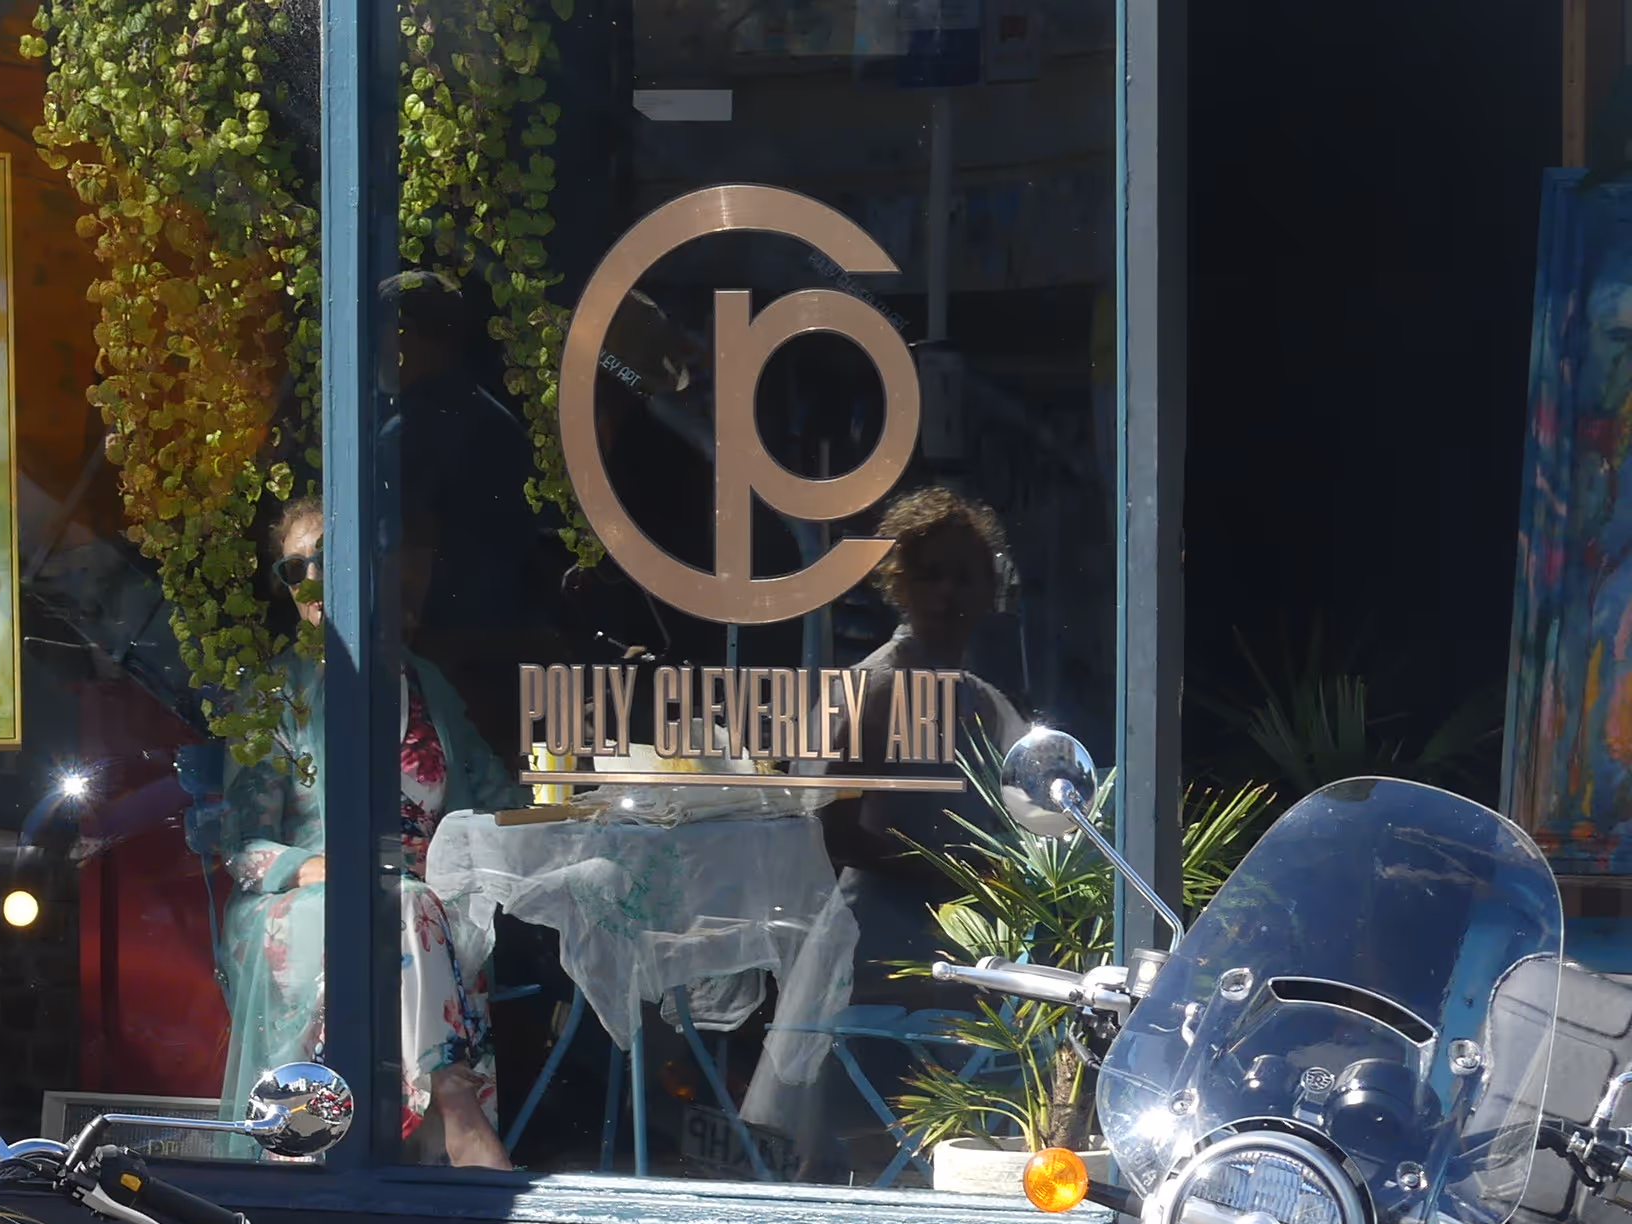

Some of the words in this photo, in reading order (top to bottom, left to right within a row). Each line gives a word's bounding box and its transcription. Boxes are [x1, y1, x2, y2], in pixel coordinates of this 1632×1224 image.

[519, 663, 638, 758] POLLY
[653, 664, 868, 762] CLEVERLEY
[884, 667, 964, 763] ART
